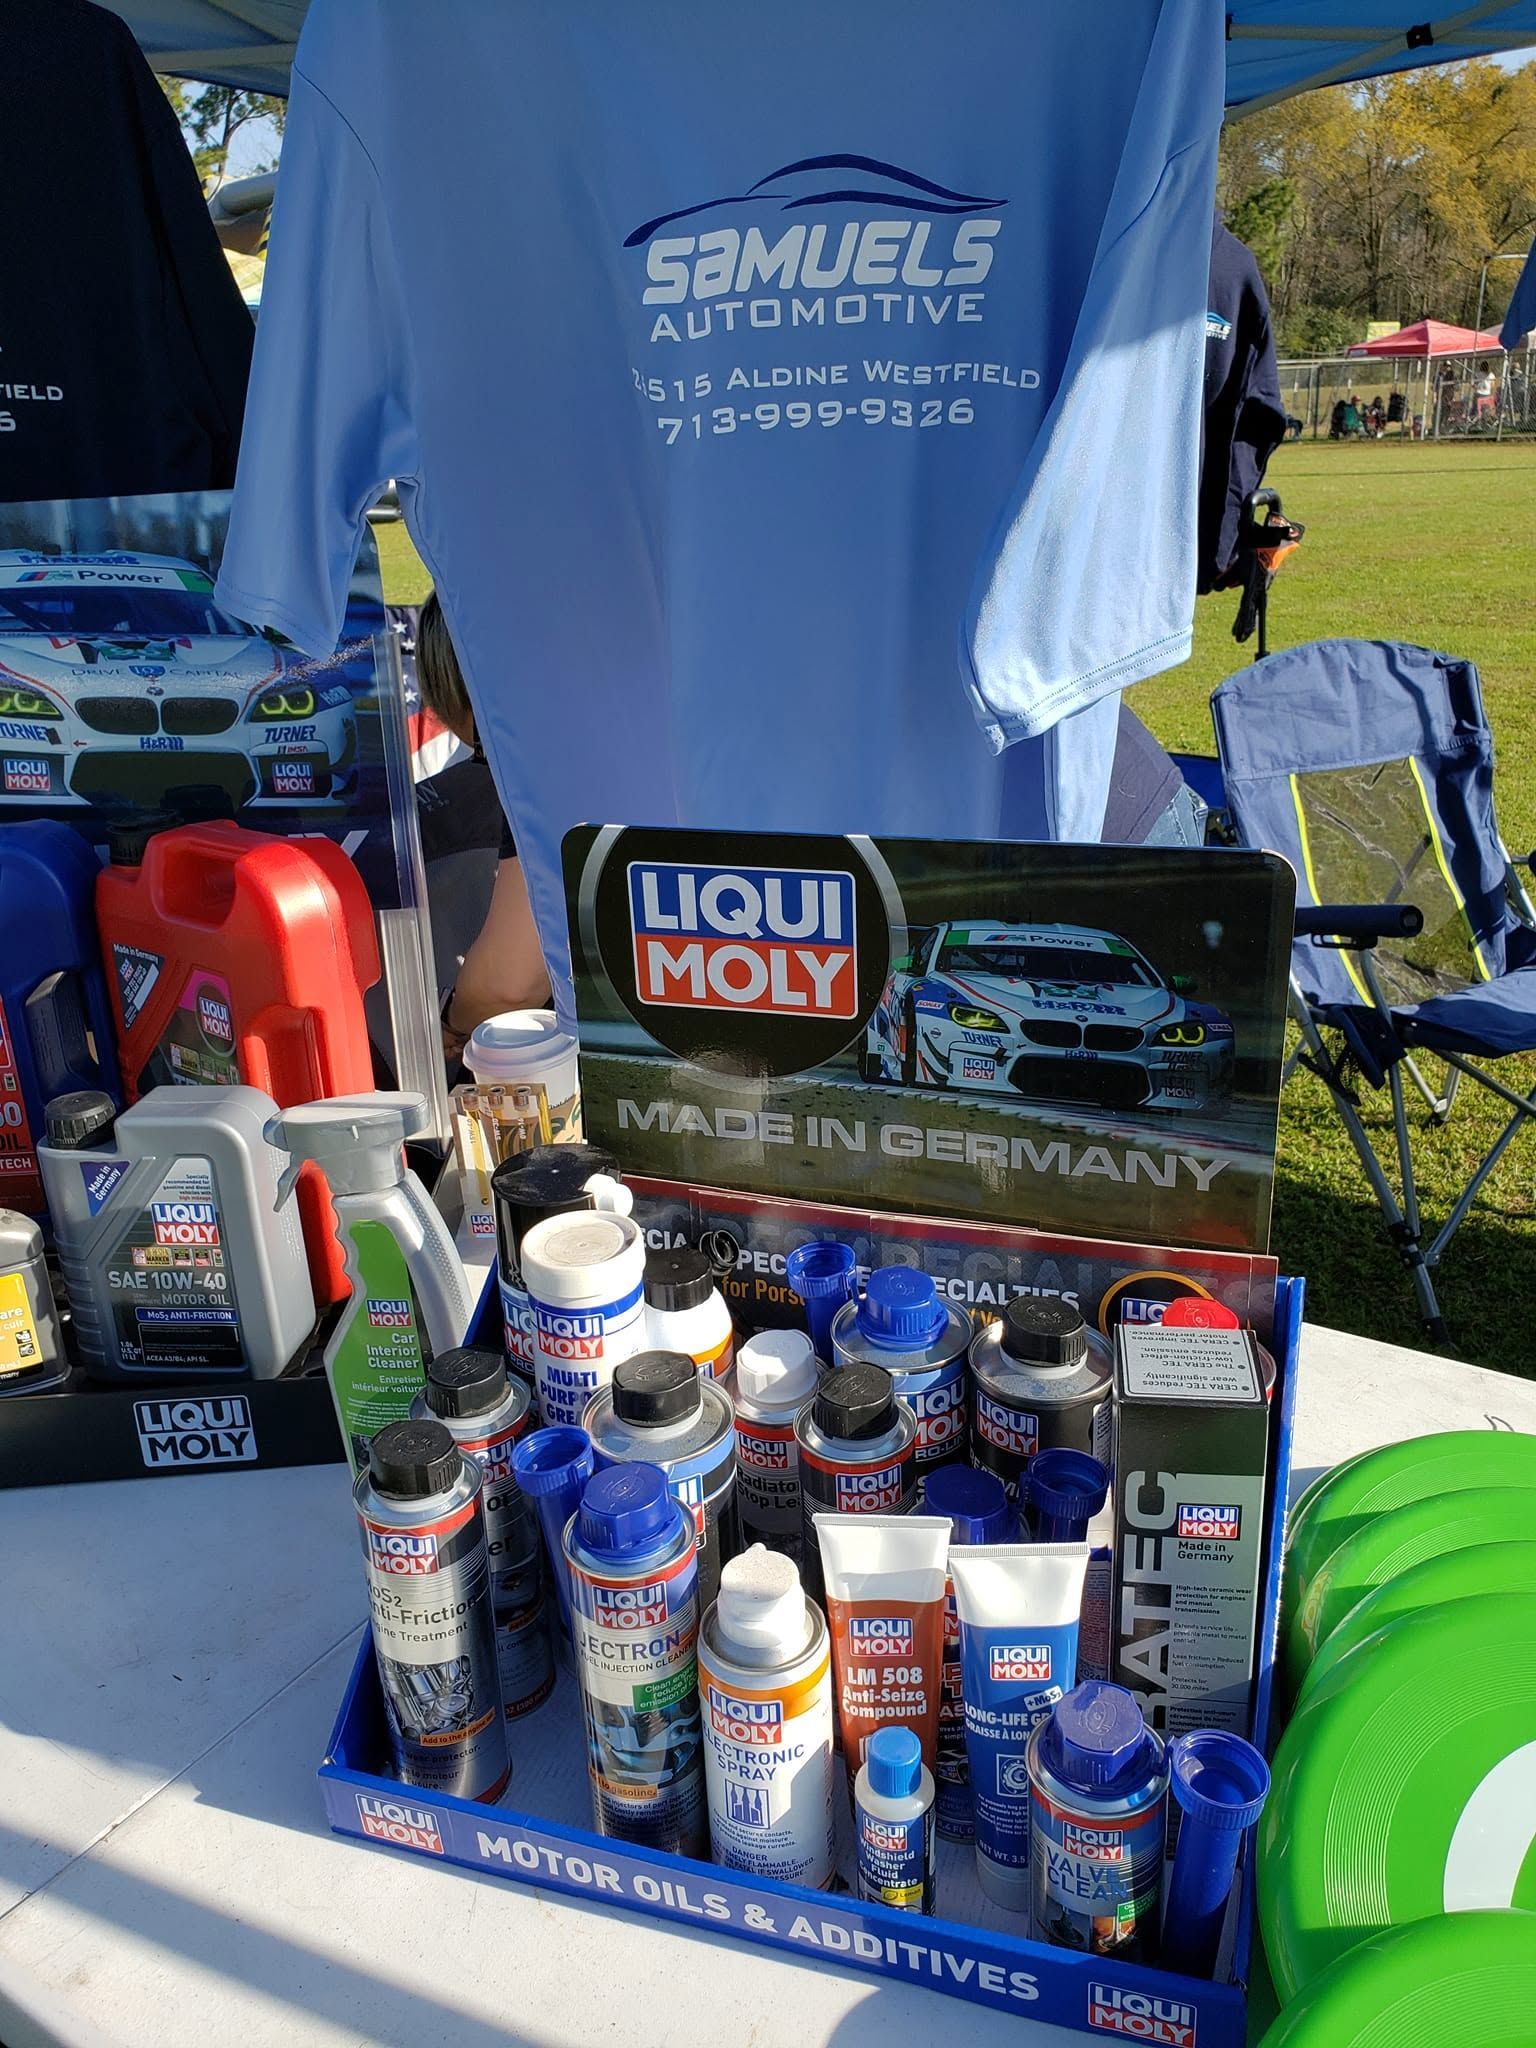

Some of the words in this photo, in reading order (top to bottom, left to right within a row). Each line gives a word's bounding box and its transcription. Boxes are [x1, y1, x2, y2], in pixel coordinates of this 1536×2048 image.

[650, 293, 985, 342] AUTOMOTIVE
[657, 398, 974, 446] 713-999-9326
[78, 571, 163, 584] Power
[265, 725, 316, 743] TURNER
[7, 761, 48, 775] LIQUI
[275, 764, 311, 777] LIQUI
[7, 775, 48, 789] MOLY
[276, 778, 312, 791] MOLY
[642, 871, 841, 940] LIQUI
[1030, 935, 1094, 949] Power
[647, 941, 850, 1008] MOLY
[201, 999, 229, 1022] LIQUI
[203, 1016, 231, 1037] MOLY
[964, 1069, 994, 1079] MOLY
[965, 1059, 994, 1070] LIQUI
[616, 1099, 795, 1145] MADE
[806, 1116, 866, 1152] IN
[880, 1124, 1232, 1193] GERMANY
[88, 1173, 106, 1193] Made
[100, 1165, 111, 1175] in
[95, 1168, 121, 1200] Germany
[154, 1205, 213, 1223] LIQUI
[158, 1225, 215, 1243] MOLY
[108, 1271, 148, 1289] SAE
[151, 1271, 227, 1290] 10W-40
[722, 1275, 748, 1298] for
[161, 1293, 206, 1305] MOTOR
[209, 1294, 230, 1305] OIL
[368, 1301, 408, 1314] LIQUI
[170, 1312, 232, 1320] ANTI-FRICTION
[371, 1314, 410, 1326] MOLY
[538, 1312, 600, 1338] LIQUI
[392, 1333, 415, 1344] Car
[540, 1332, 601, 1358] MOLY
[367, 1345, 417, 1357] Interior
[368, 1357, 419, 1369] Cleaner
[379, 1375, 423, 1385] Entretien
[547, 1365, 597, 1387] MULTI
[1143, 1372, 1208, 1382] significantly.
[1209, 1383, 1238, 1391] CERA
[141, 1402, 245, 1432] LIQUI
[980, 1393, 1034, 1435] LIQUI
[740, 1434, 784, 1454] LIQUI
[980, 1414, 1036, 1454] MOLY
[146, 1433, 249, 1462] MOLY
[741, 1448, 786, 1468] MOLY
[841, 1467, 899, 1493] LIQUI
[738, 1482, 770, 1509] Stop
[841, 1485, 899, 1511] MOLY
[1182, 1507, 1235, 1523] LIQUI
[1181, 1521, 1237, 1537] MOLY
[371, 1532, 433, 1556] LIQUI
[1178, 1541, 1211, 1552] Made
[1215, 1542, 1226, 1552] in
[373, 1552, 435, 1574] MOLY
[1178, 1551, 1234, 1563] Germany
[597, 1585, 662, 1609] LIQUI
[598, 1604, 664, 1628] MOLY
[399, 1622, 467, 1642] Treatment
[853, 1620, 910, 1638] LIQUI
[580, 1630, 680, 1660] JECTRON
[854, 1639, 911, 1655] MOLY
[994, 1648, 1047, 1663] LIQUI
[601, 1662, 653, 1673] INJECTION
[847, 1667, 877, 1685] LM
[882, 1667, 923, 1685] 508
[994, 1664, 1048, 1678] MOLY
[645, 1681, 671, 1693] Clean
[842, 1685, 925, 1703] Anti-Seize
[640, 1689, 679, 1708] emission
[712, 1690, 777, 1723] LIQUI
[842, 1699, 927, 1720] Compound
[965, 1701, 1028, 1726] LONG-LIFE
[713, 1711, 779, 1743] MOLY
[966, 1718, 1000, 1739] GRAISSE
[1002, 1728, 1010, 1740] À
[704, 1721, 804, 1765] ELECTRONIC
[718, 1754, 776, 1781] SPRAY
[361, 1798, 436, 1833] LIQUI
[364, 1817, 440, 1851] MOLY
[865, 1817, 905, 1838] LIQUI
[1066, 1824, 1119, 1846] LIQUI
[860, 1835, 915, 1861] Windshield
[865, 1828, 906, 1849] MOLY
[1067, 1839, 1120, 1859] MOLY
[732, 1846, 768, 1861] DANGER
[865, 1851, 905, 1870] Washer
[871, 1865, 898, 1879] Fluid
[1047, 1846, 1117, 1883] VALVE
[1048, 1866, 1128, 1899] CLEAN
[476, 1831, 624, 1893] MOTOR
[632, 1874, 731, 1920] OILS
[744, 1903, 778, 1933] &
[788, 1916, 1040, 2001] ADDITIVES
[1095, 1985, 1191, 2025] LIQUI
[1095, 2007, 1193, 2045] MOLY
